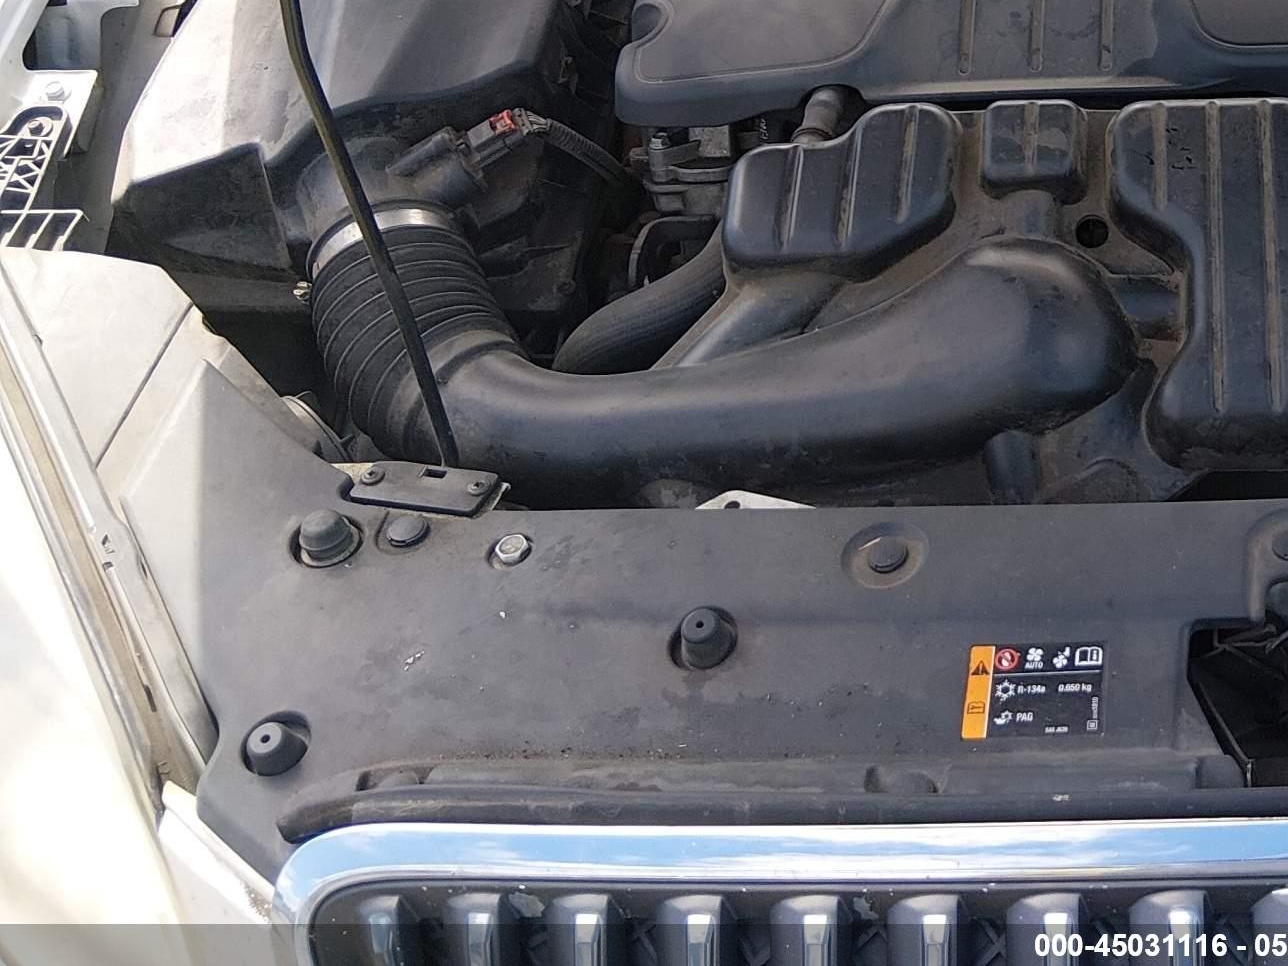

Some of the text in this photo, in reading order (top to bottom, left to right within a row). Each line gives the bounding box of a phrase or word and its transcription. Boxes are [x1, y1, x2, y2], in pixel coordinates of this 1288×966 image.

[1025, 661, 1043, 669] AUTO
[1017, 684, 1046, 694] R-134a
[1081, 683, 1092, 692] kg
[1016, 712, 1033, 722] PAG
